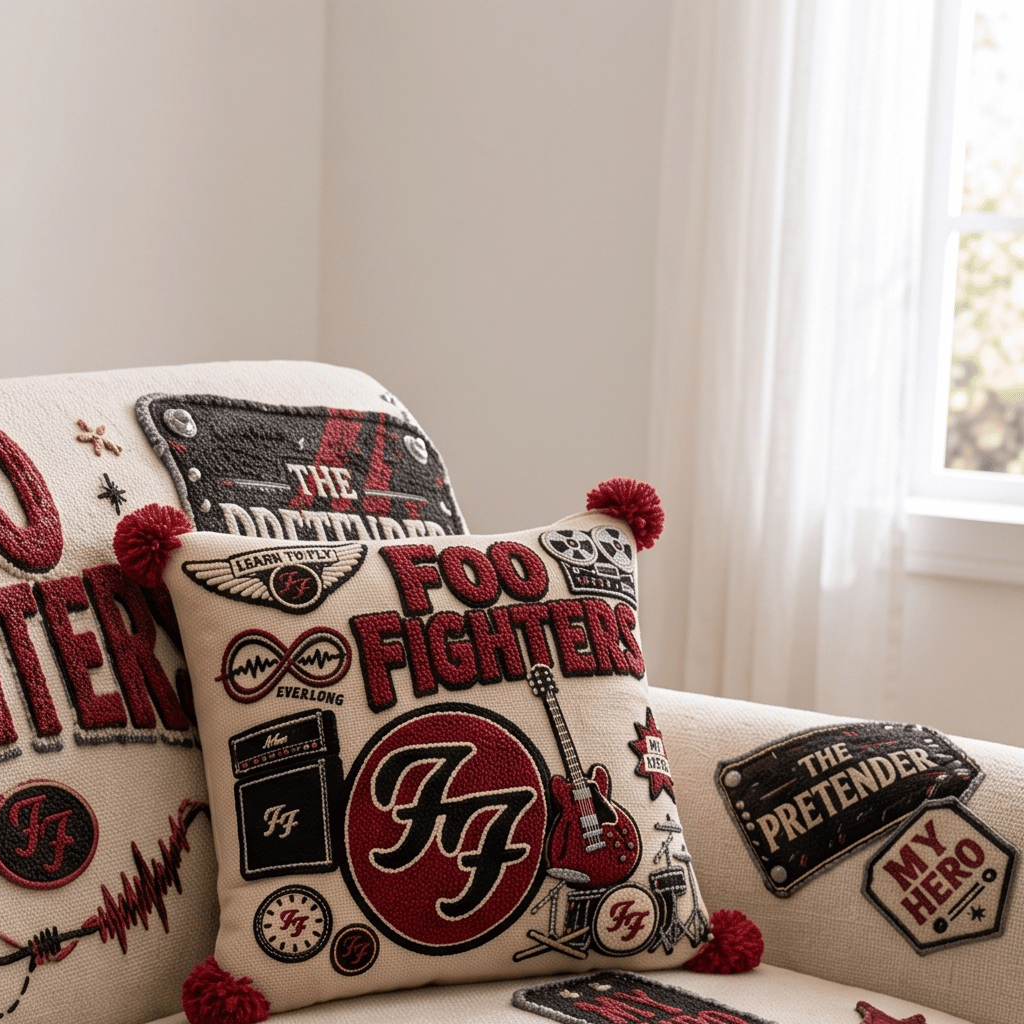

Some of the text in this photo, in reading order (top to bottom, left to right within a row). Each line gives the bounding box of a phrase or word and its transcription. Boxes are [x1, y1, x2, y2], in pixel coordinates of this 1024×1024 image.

[287, 463, 358, 499] THE
[236, 552, 283, 572] LEARN
[284, 550, 304, 561] TO
[379, 541, 549, 617] FOO
[349, 598, 645, 714] FIGHTERS
[276, 686, 344, 706] EVERLONG
[798, 742, 854, 778] THE
[263, 804, 300, 838] FF
[756, 748, 939, 854] PRETENDER
[8, 794, 77, 874] FF
[369, 742, 538, 921] FF
[883, 820, 947, 891] MY
[901, 838, 985, 926] HERO
[280, 909, 309, 937] FF
[607, 900, 650, 941] FF
